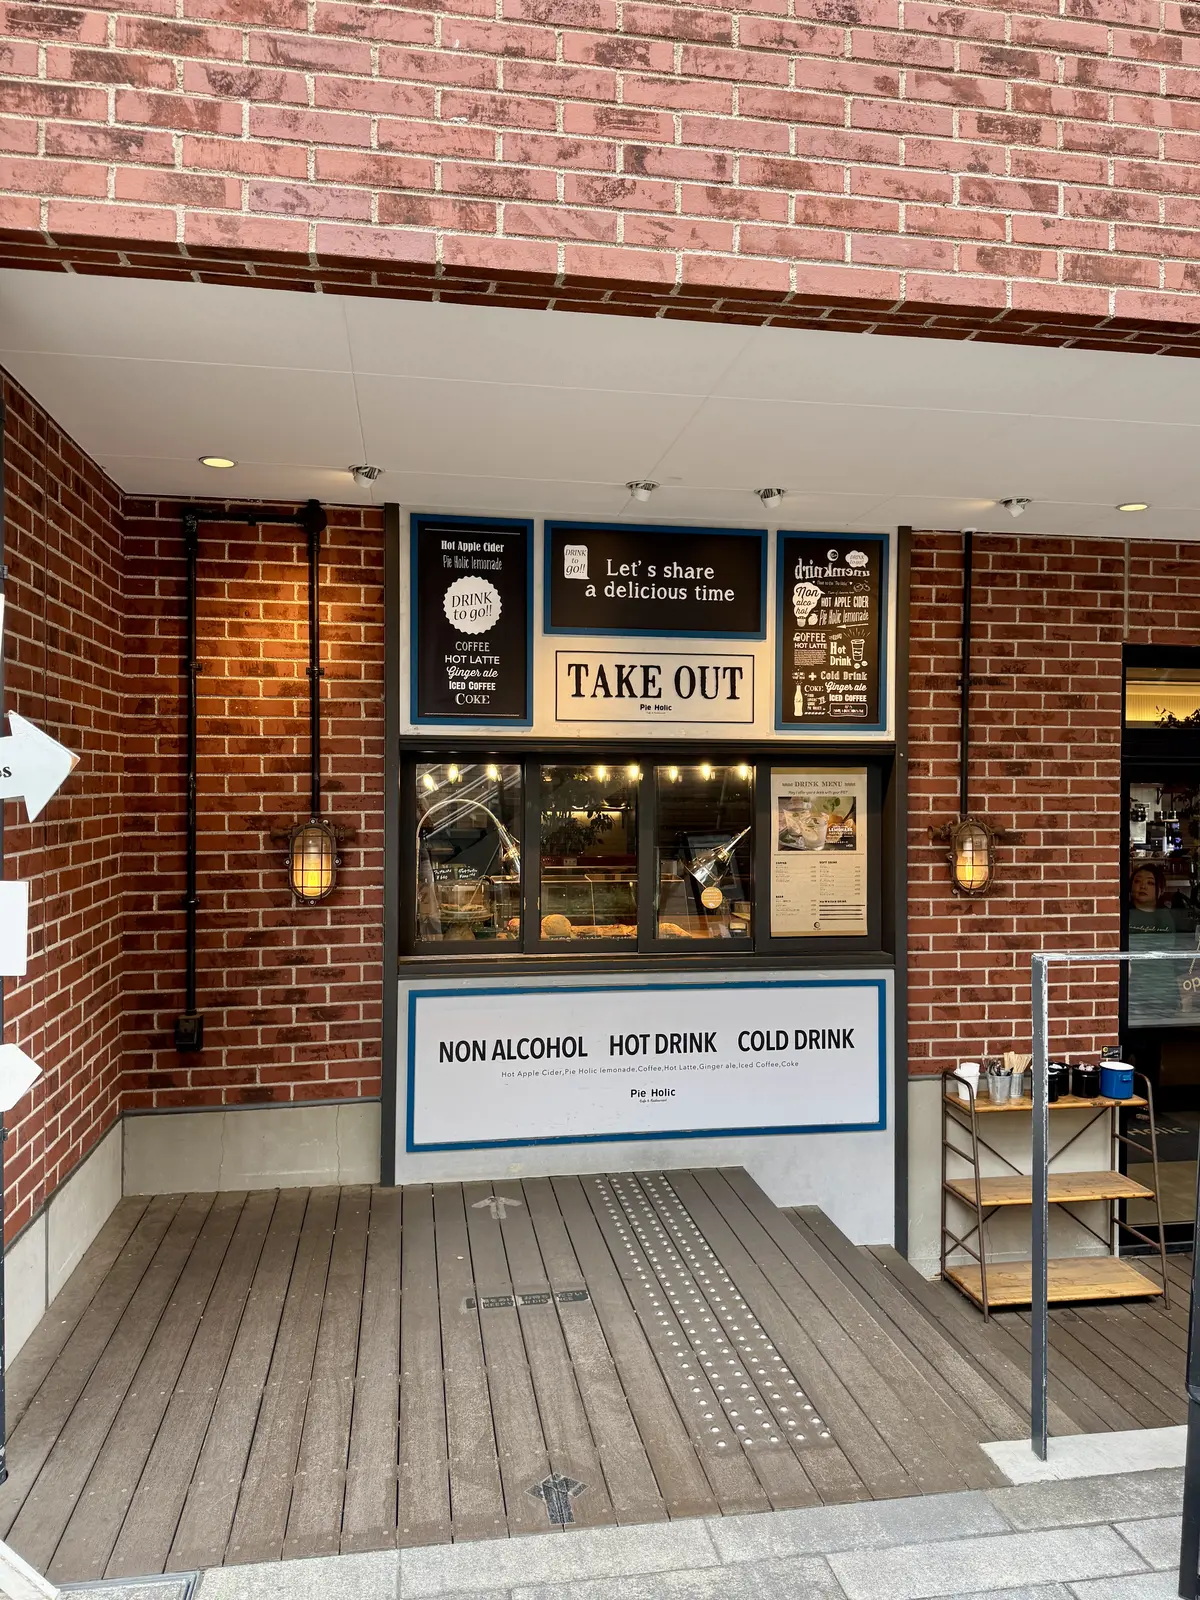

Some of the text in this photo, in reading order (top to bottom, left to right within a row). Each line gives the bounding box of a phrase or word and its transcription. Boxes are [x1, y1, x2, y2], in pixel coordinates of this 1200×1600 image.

[442, 540, 504, 552] Hot Apple Cider
[443, 555, 452, 568] Pie
[454, 555, 469, 568] Holic
[566, 564, 586, 575] go!!
[664, 562, 714, 579] share
[586, 582, 735, 601] a delicious time
[796, 587, 819, 598] Non
[452, 592, 492, 607] DRINK
[821, 596, 869, 608] HOT APPLE CIDER
[454, 605, 492, 622] to go!!
[794, 633, 826, 642] COFFEE
[455, 642, 490, 652] COFFEE
[830, 642, 846, 654] Hot
[445, 655, 500, 664] HOT LATTE
[830, 656, 851, 666] Drink
[446, 666, 498, 678] Ginger ale
[821, 671, 867, 680] Cold Drink
[568, 663, 743, 699] TAKE OUT
[825, 682, 853, 693] Ginger
[440, 1028, 855, 1063] NON ALCOHOL HOT DRINK COLD DRINK
[631, 1089, 646, 1098] Pie
